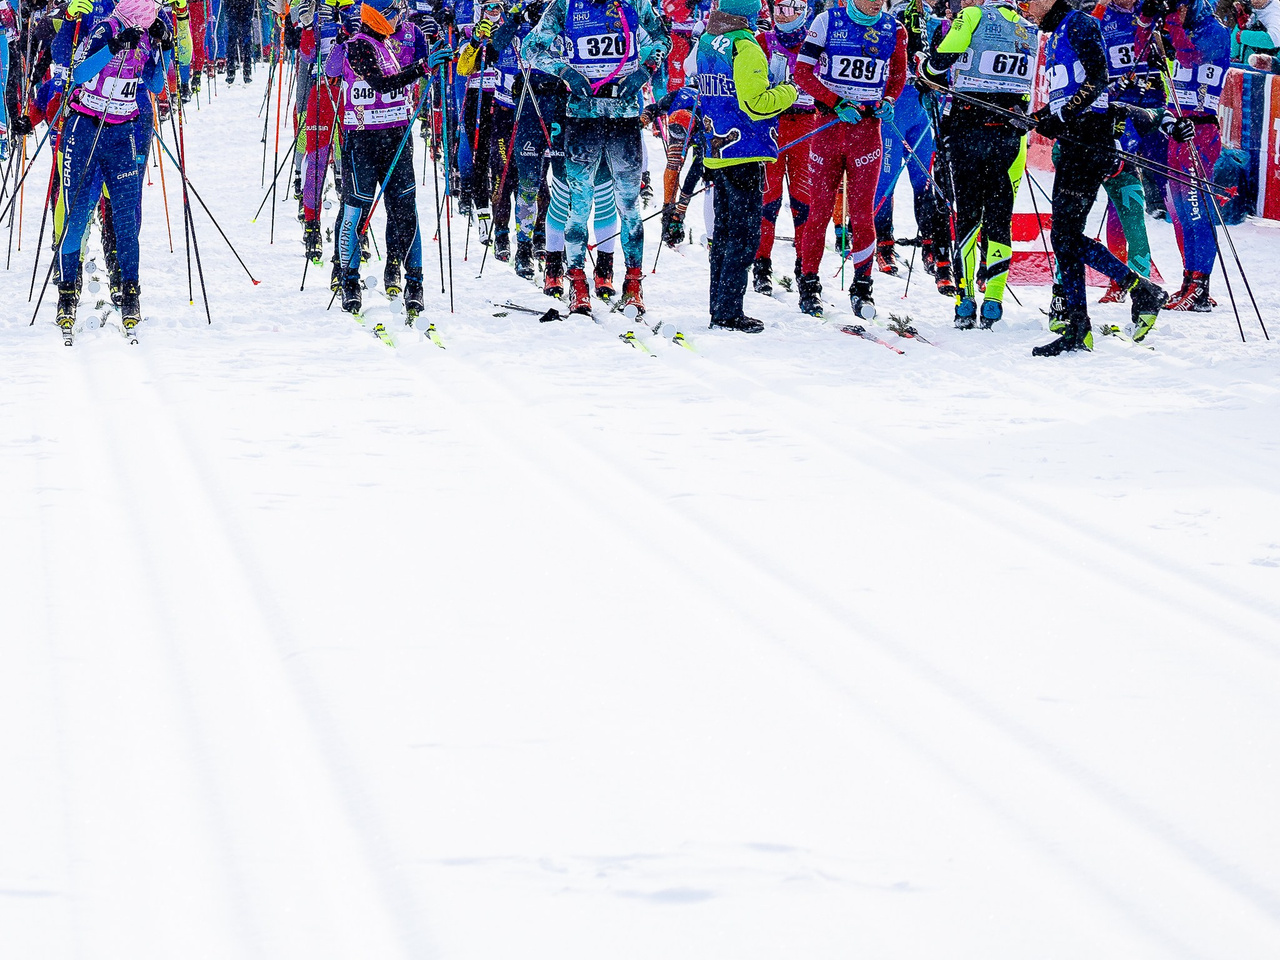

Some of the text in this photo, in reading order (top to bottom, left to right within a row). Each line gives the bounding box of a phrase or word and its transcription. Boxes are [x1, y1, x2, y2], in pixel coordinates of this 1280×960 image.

[587, 36, 626, 57] 320
[711, 35, 731, 55] 42
[838, 58, 878, 80] 289
[993, 54, 1029, 76] 678
[1206, 67, 1215, 79] 3
[353, 87, 374, 100] 348
[64, 145, 73, 187] CRAFT
[854, 148, 880, 168] BOSCO
[884, 138, 893, 173] SPINE
